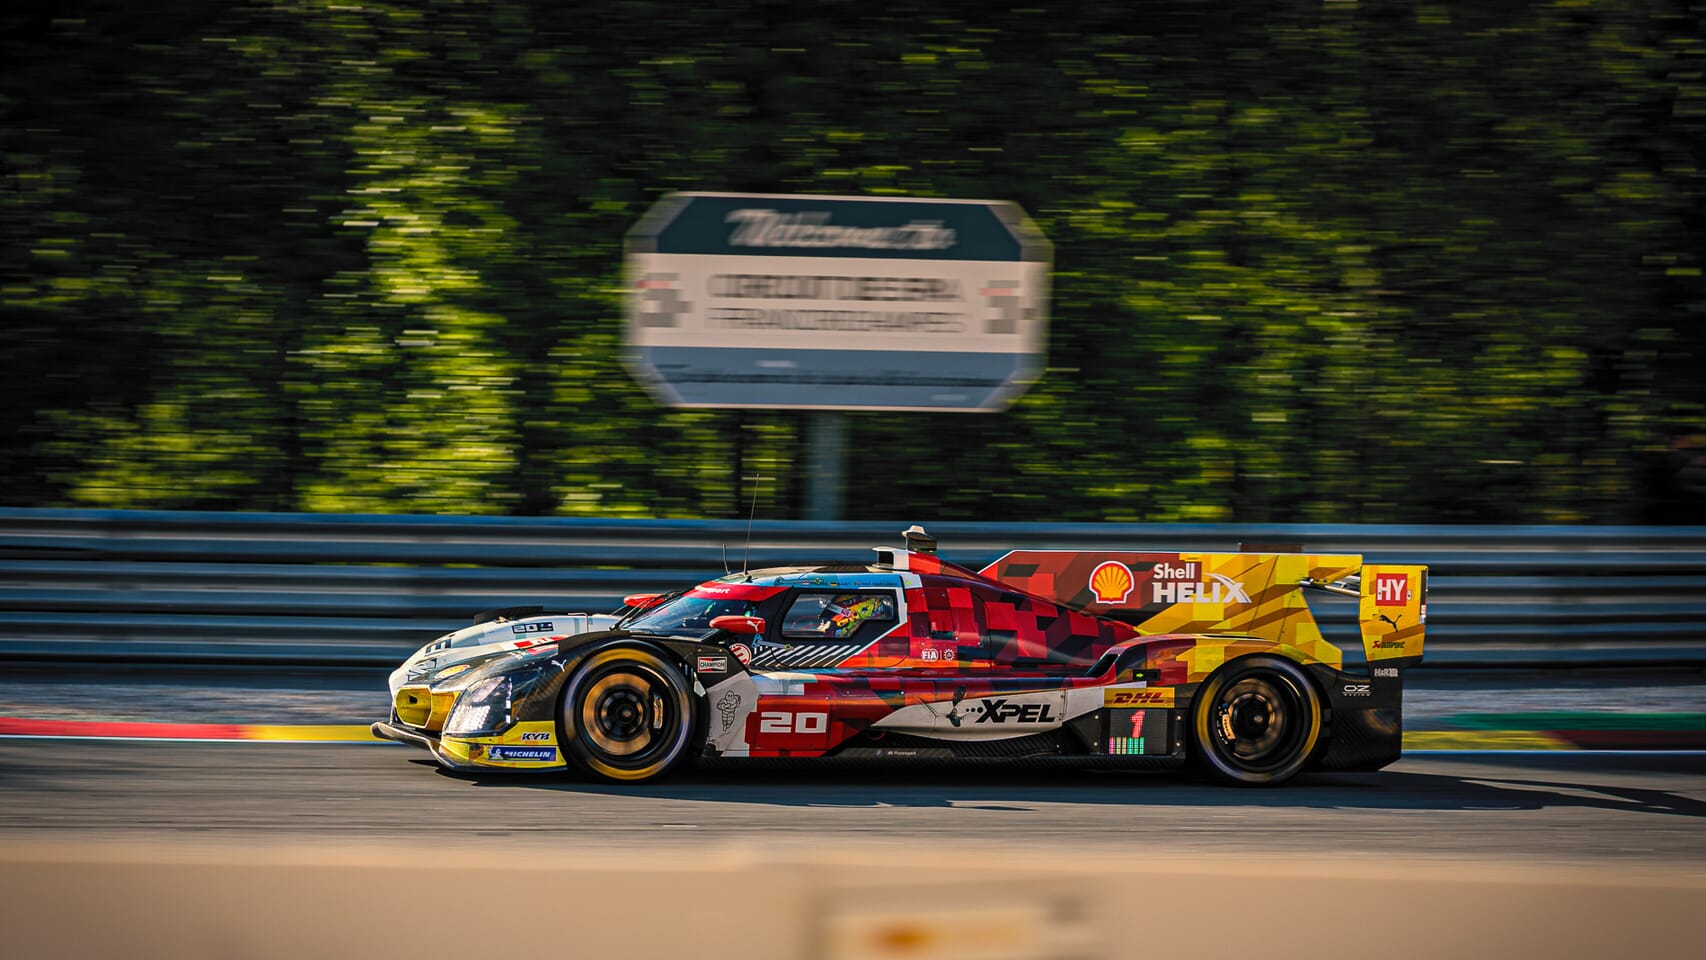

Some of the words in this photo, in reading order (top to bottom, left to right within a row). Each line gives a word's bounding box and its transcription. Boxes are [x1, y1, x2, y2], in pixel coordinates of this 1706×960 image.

[1153, 563, 1195, 579] Shell
[1152, 579, 1252, 604] HELIX
[1377, 578, 1406, 601] HY
[513, 623, 539, 633] 20
[921, 651, 937, 660] FIA
[1343, 684, 1371, 692] OZ
[1113, 692, 1165, 705] DHL
[975, 699, 1056, 723] XPEL
[760, 711, 828, 734] 20
[1129, 709, 1146, 738] 1
[521, 732, 551, 741] KYB
